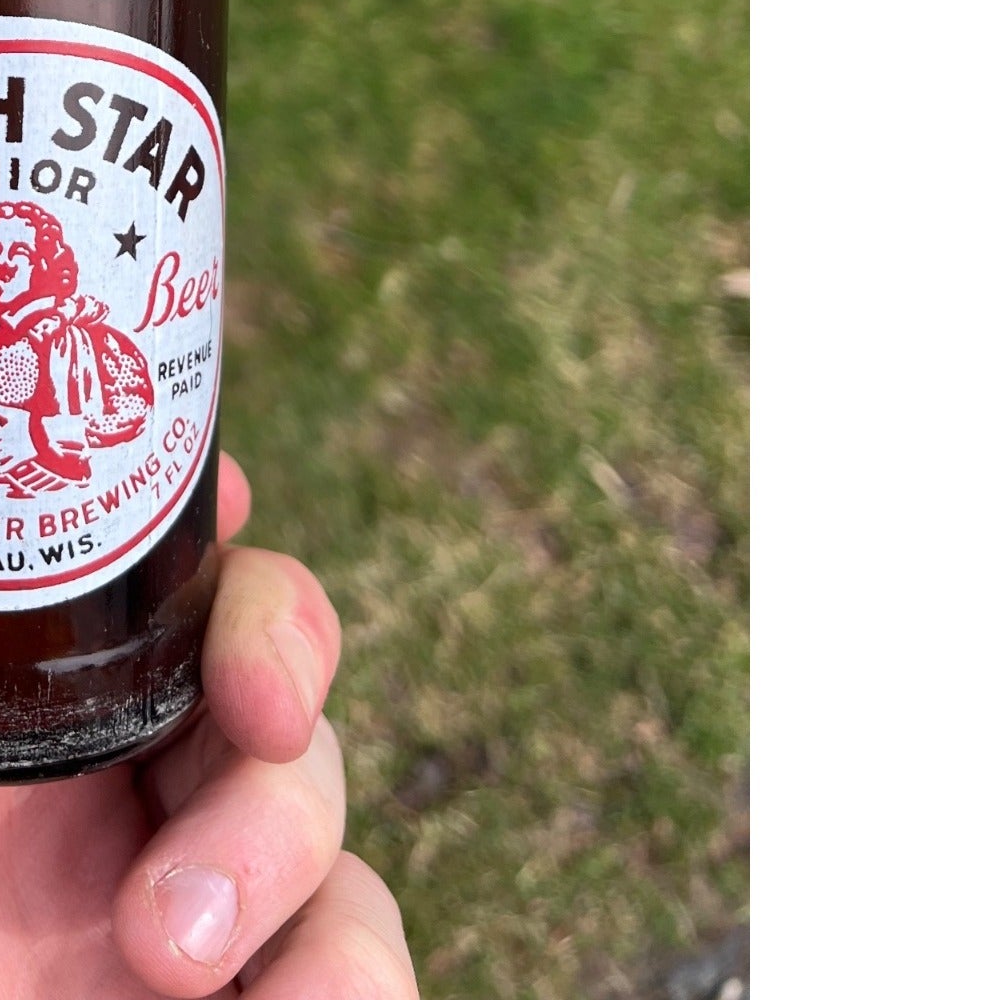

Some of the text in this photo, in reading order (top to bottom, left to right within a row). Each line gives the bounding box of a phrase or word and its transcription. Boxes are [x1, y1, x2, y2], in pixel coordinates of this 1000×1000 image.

[51, 82, 206, 222] STAR
[133, 251, 218, 333] Beer
[158, 339, 213, 382] REVENUE
[171, 372, 202, 400] PAID
[39, 452, 161, 538] BREWING
[163, 416, 190, 453] CO.
[151, 423, 200, 500] 7 FL OZ
[39, 533, 103, 566] WIS.
